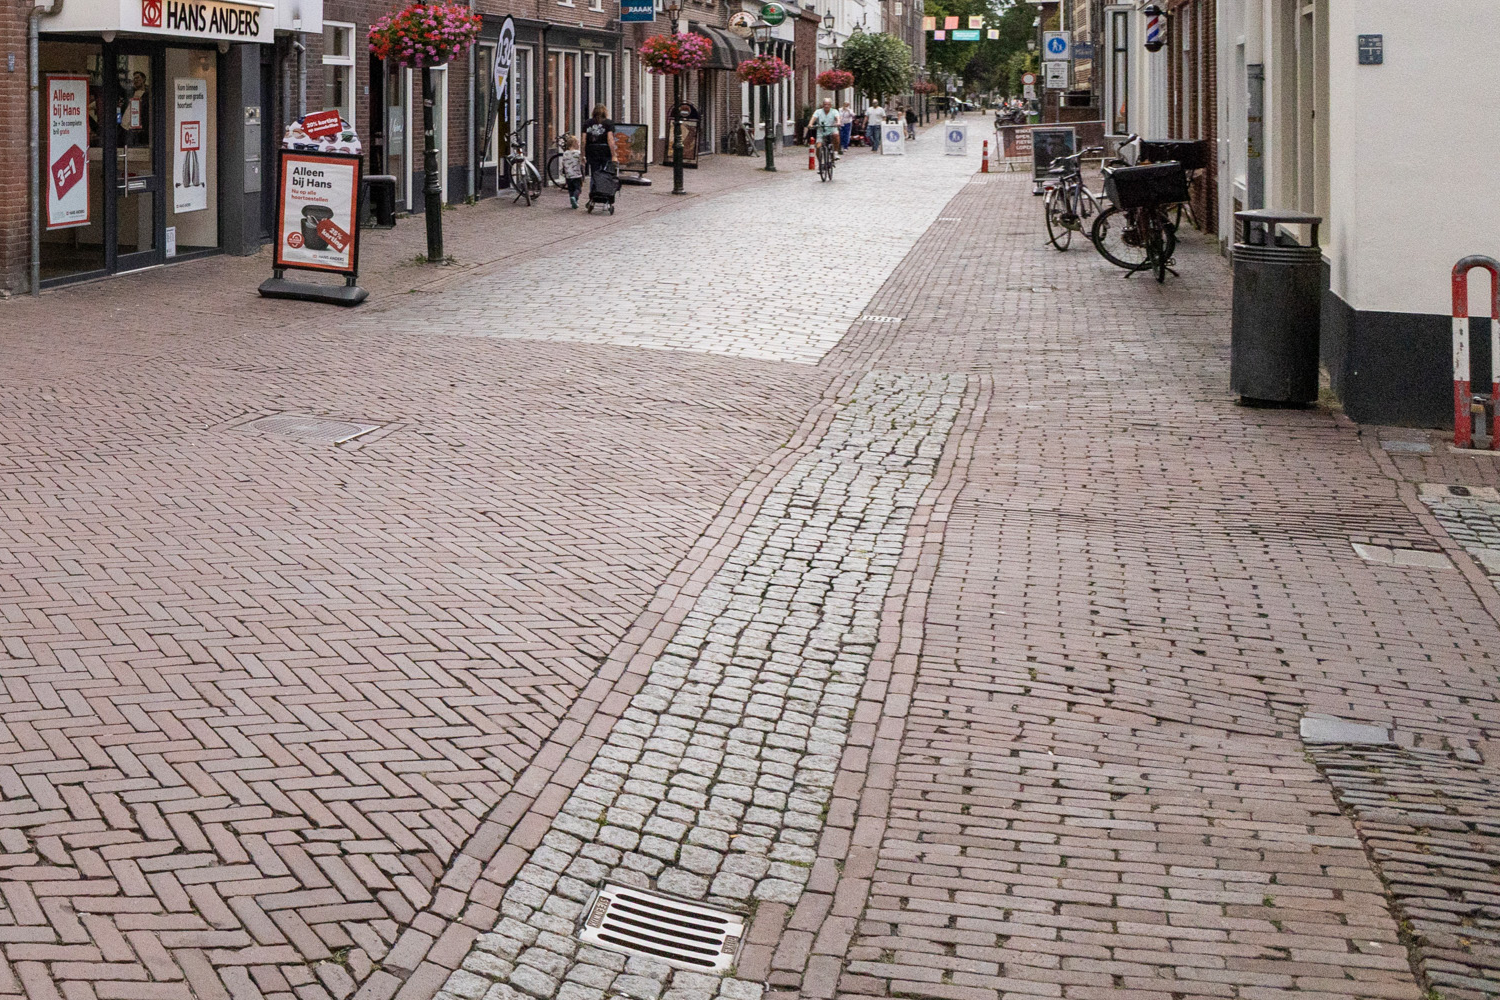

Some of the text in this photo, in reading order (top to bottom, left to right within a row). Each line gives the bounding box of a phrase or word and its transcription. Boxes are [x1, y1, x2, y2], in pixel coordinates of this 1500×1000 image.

[166, 0, 260, 37] HANS ANDERS
[53, 89, 75, 101] Alleen
[53, 104, 81, 118] bij Hans
[57, 157, 77, 187] 3=1
[293, 167, 325, 178] Alleen
[292, 177, 332, 189] bij Hans
